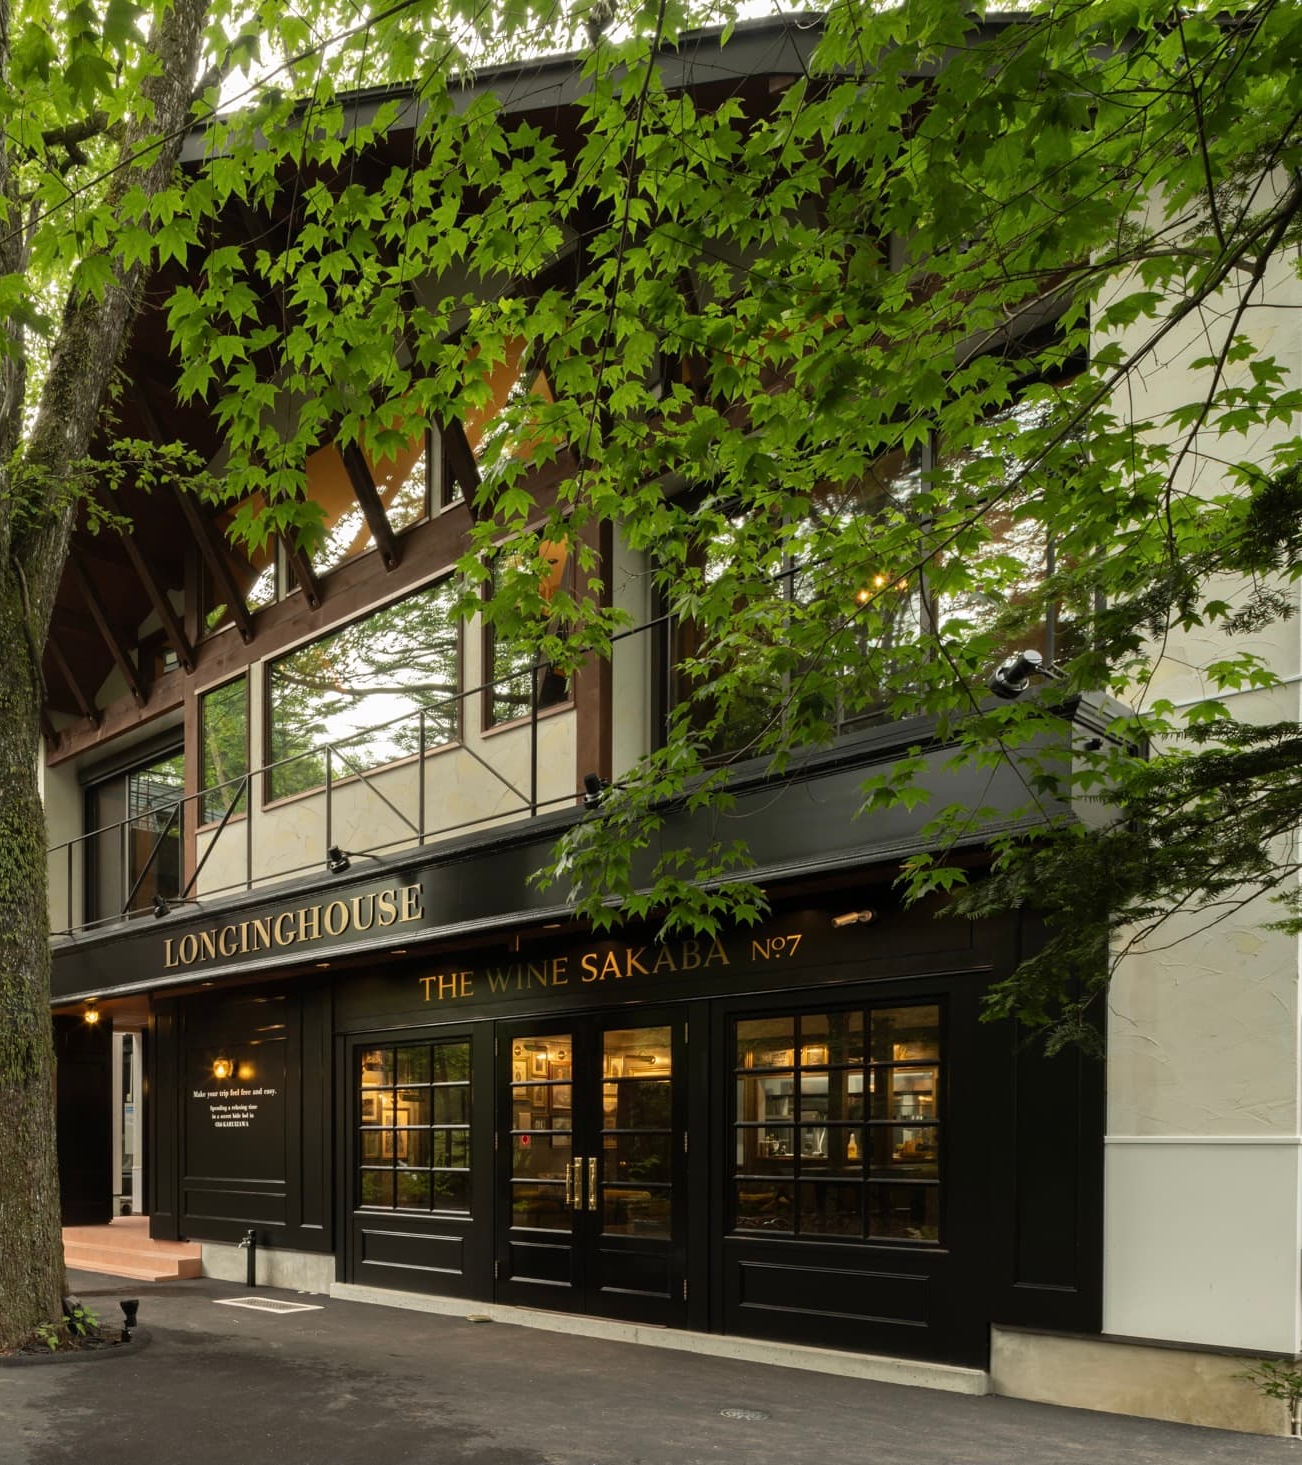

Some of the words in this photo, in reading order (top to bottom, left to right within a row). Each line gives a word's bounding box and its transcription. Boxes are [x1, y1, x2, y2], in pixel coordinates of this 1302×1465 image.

[163, 883, 424, 968] LONGINGHOUSE
[419, 971, 474, 1001] THE
[486, 957, 568, 993] WINE
[581, 936, 730, 983] SAKABA
[193, 1090, 206, 1098] Make
[207, 1091, 218, 1099] your
[219, 1089, 229, 1098] trip
[230, 1088, 239, 1096] feel
[241, 1088, 251, 1096] free
[253, 1087, 262, 1095] and
